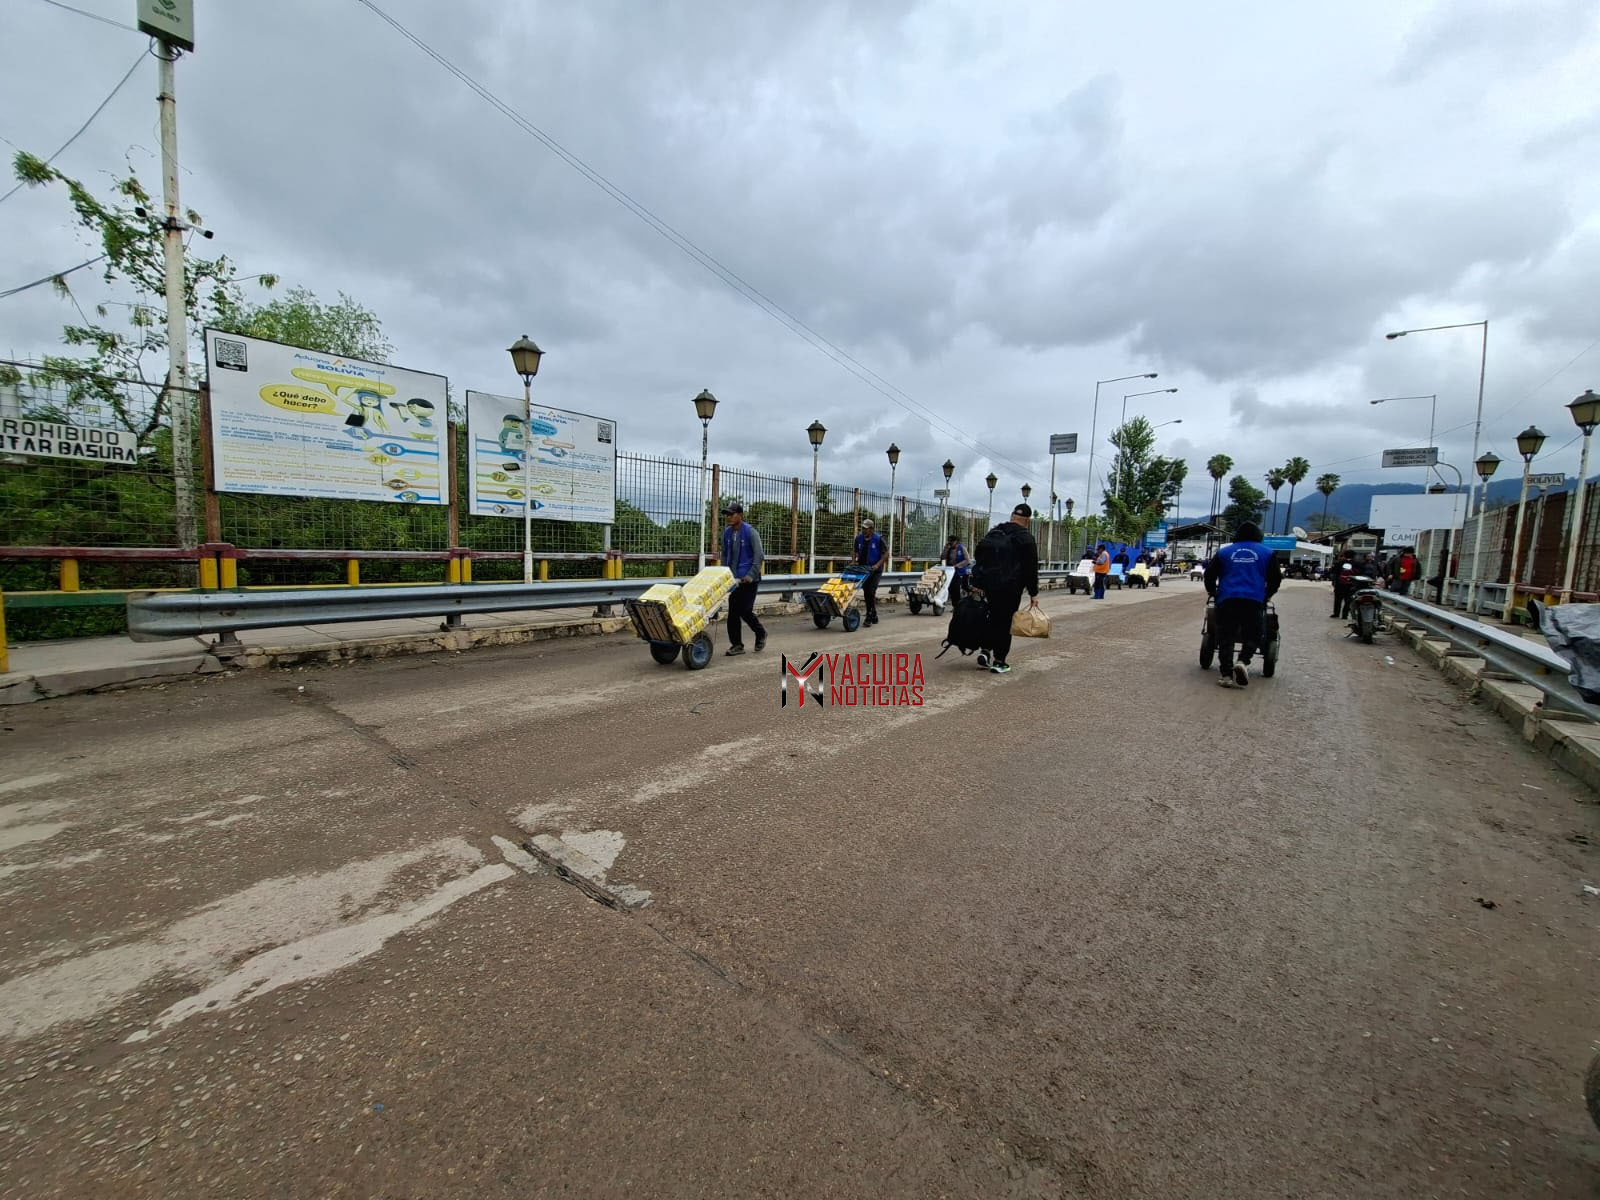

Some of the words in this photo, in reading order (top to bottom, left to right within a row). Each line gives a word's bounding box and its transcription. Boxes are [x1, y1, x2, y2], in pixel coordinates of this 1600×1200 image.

[316, 364, 366, 377] BOLIVIA
[283, 398, 318, 409] hacer?
[302, 395, 327, 403] debo
[3, 419, 119, 446] ROHIBIDO
[58, 441, 136, 461] BASURA
[1526, 475, 1562, 484] BOLIVIA
